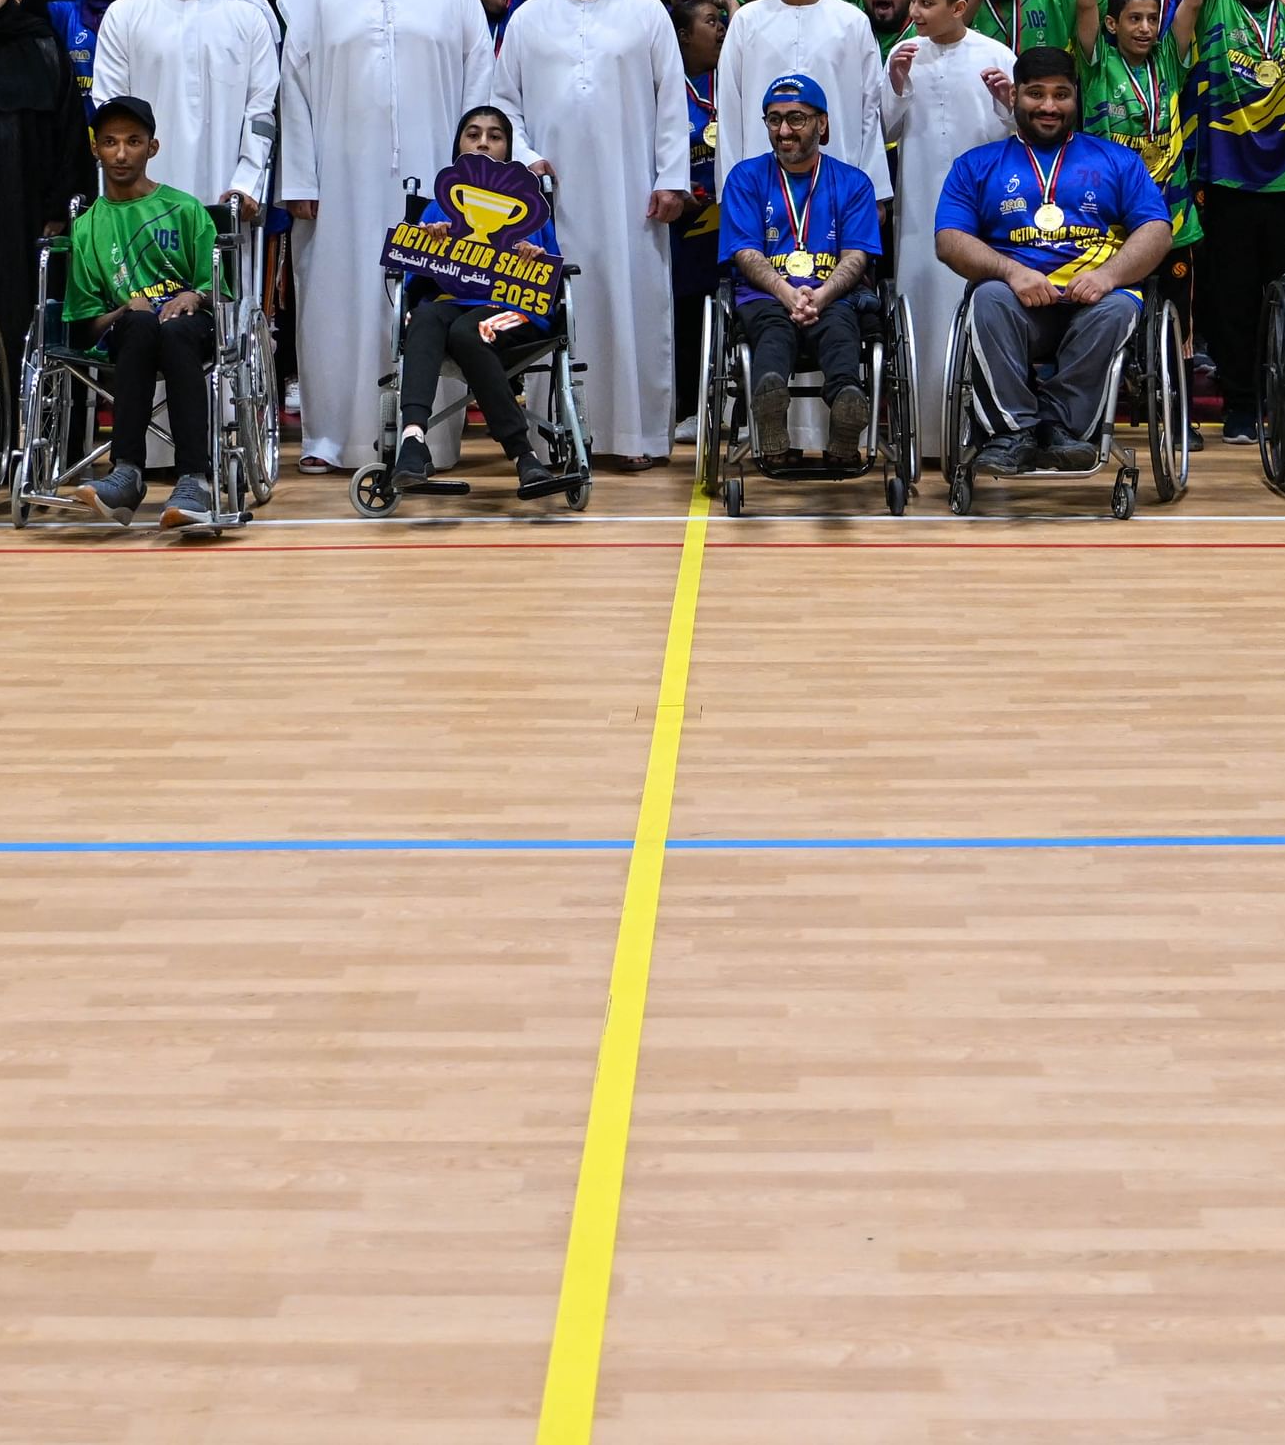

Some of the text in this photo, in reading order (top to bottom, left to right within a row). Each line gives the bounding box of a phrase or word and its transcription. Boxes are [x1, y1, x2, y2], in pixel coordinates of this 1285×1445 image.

[388, 247, 491, 286] ملتقى الأندية النشيطة
[390, 223, 555, 287] ACTIVE CLUB SERIES
[490, 279, 552, 316] 2025
